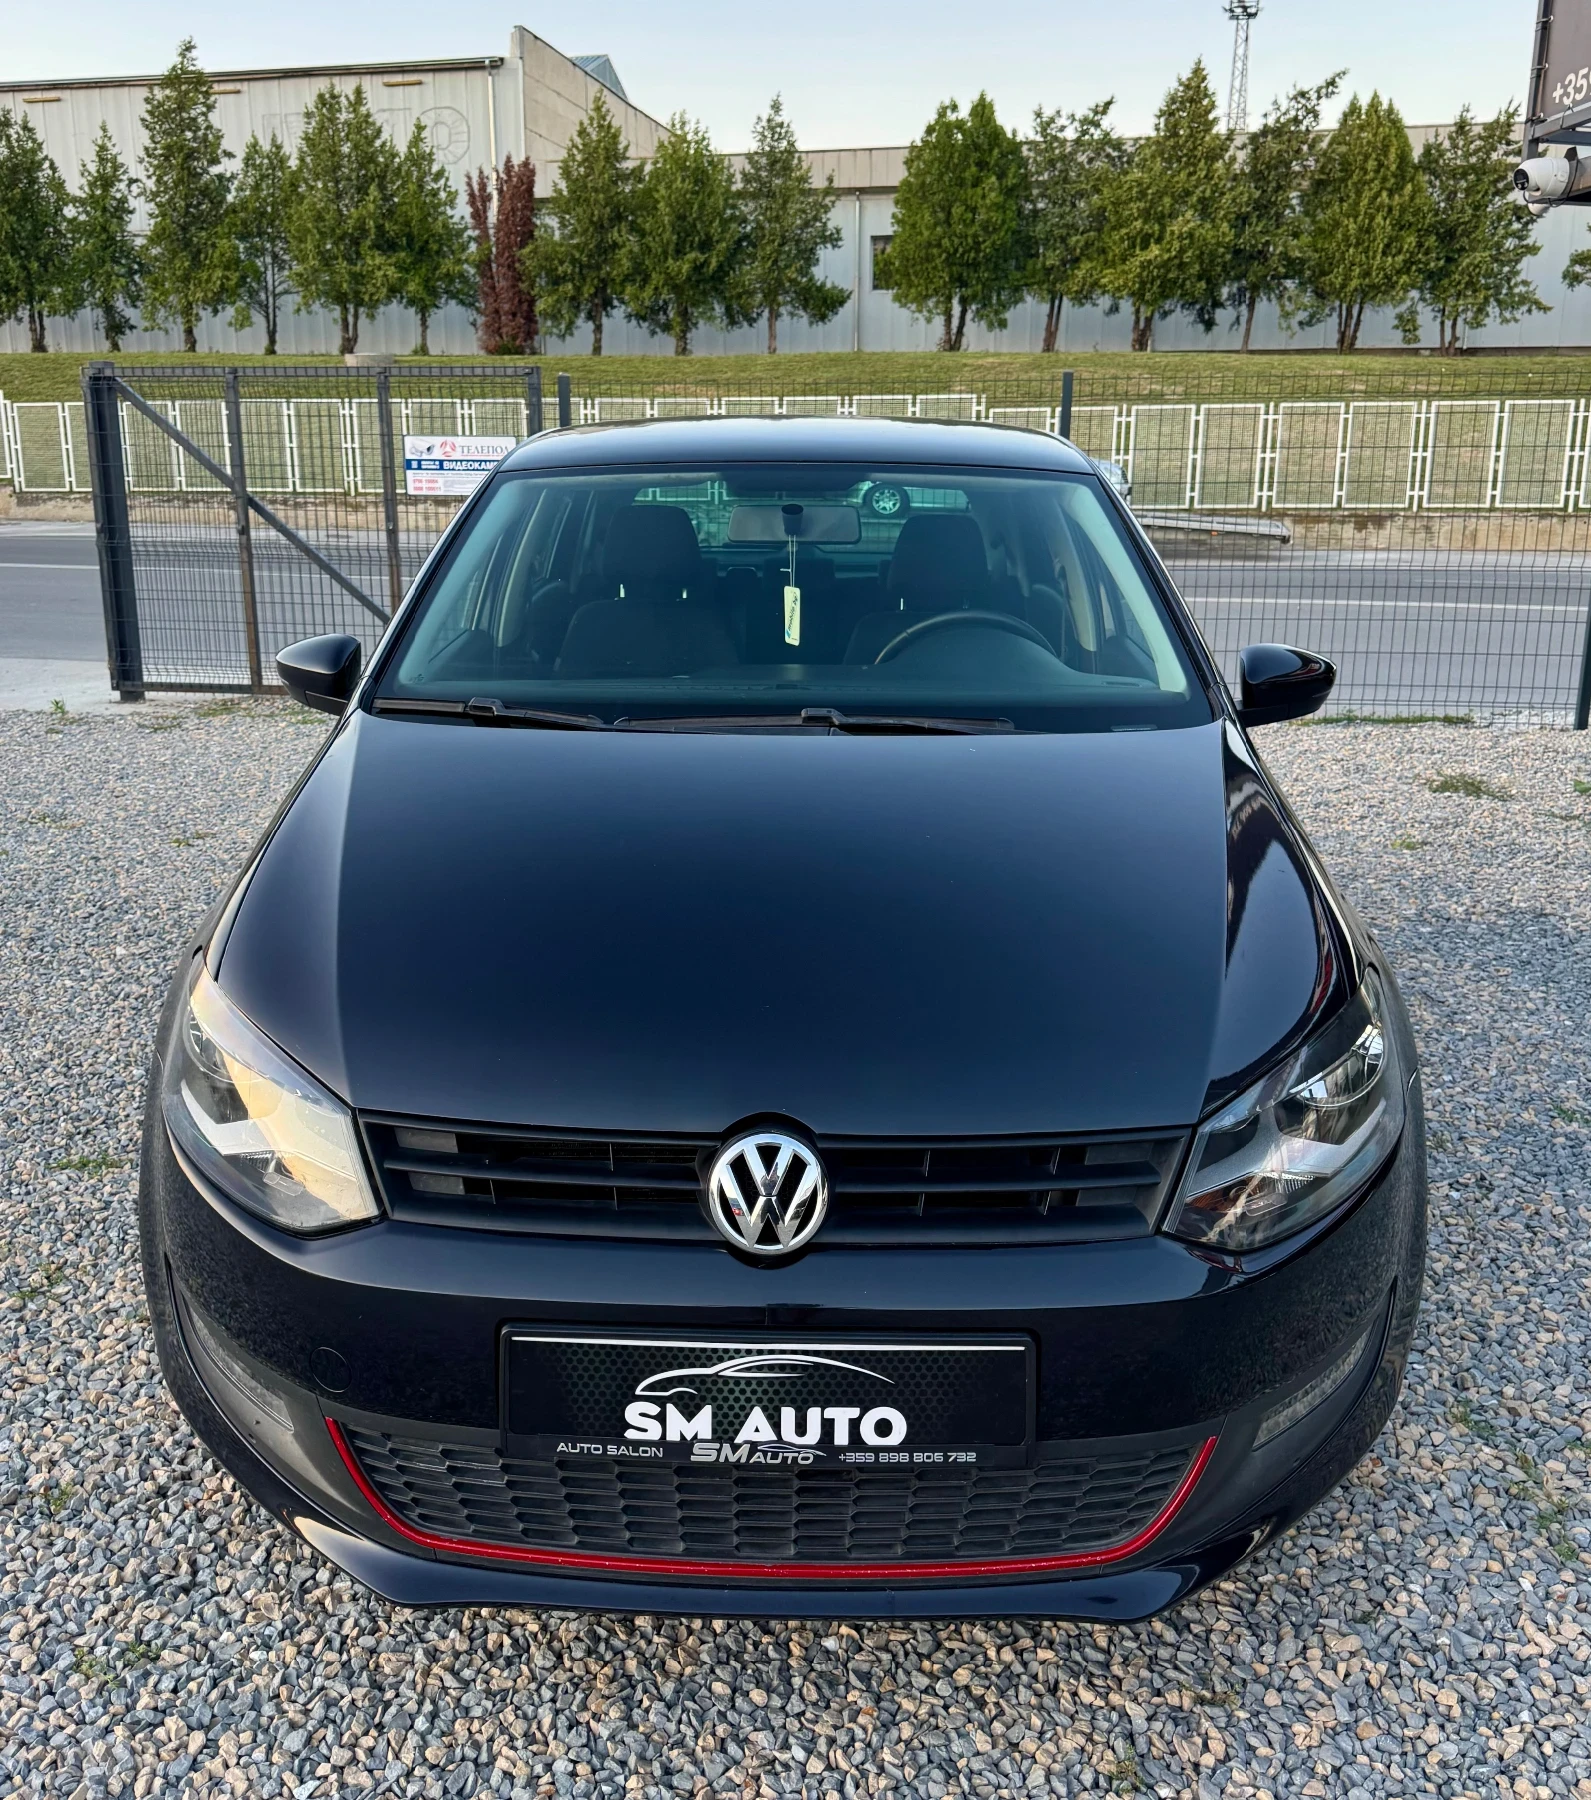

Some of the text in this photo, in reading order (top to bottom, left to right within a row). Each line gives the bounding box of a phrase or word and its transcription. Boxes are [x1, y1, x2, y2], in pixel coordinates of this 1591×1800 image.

[1552, 67, 1591, 106] +35
[460, 445, 509, 454] ТЕЛЕПОЛ
[624, 1401, 907, 1445] SM AUTO
[557, 1442, 663, 1457] AUTO SALON
[690, 1442, 814, 1464] SM AUTO
[838, 1452, 977, 1463] +359 898 806 732
